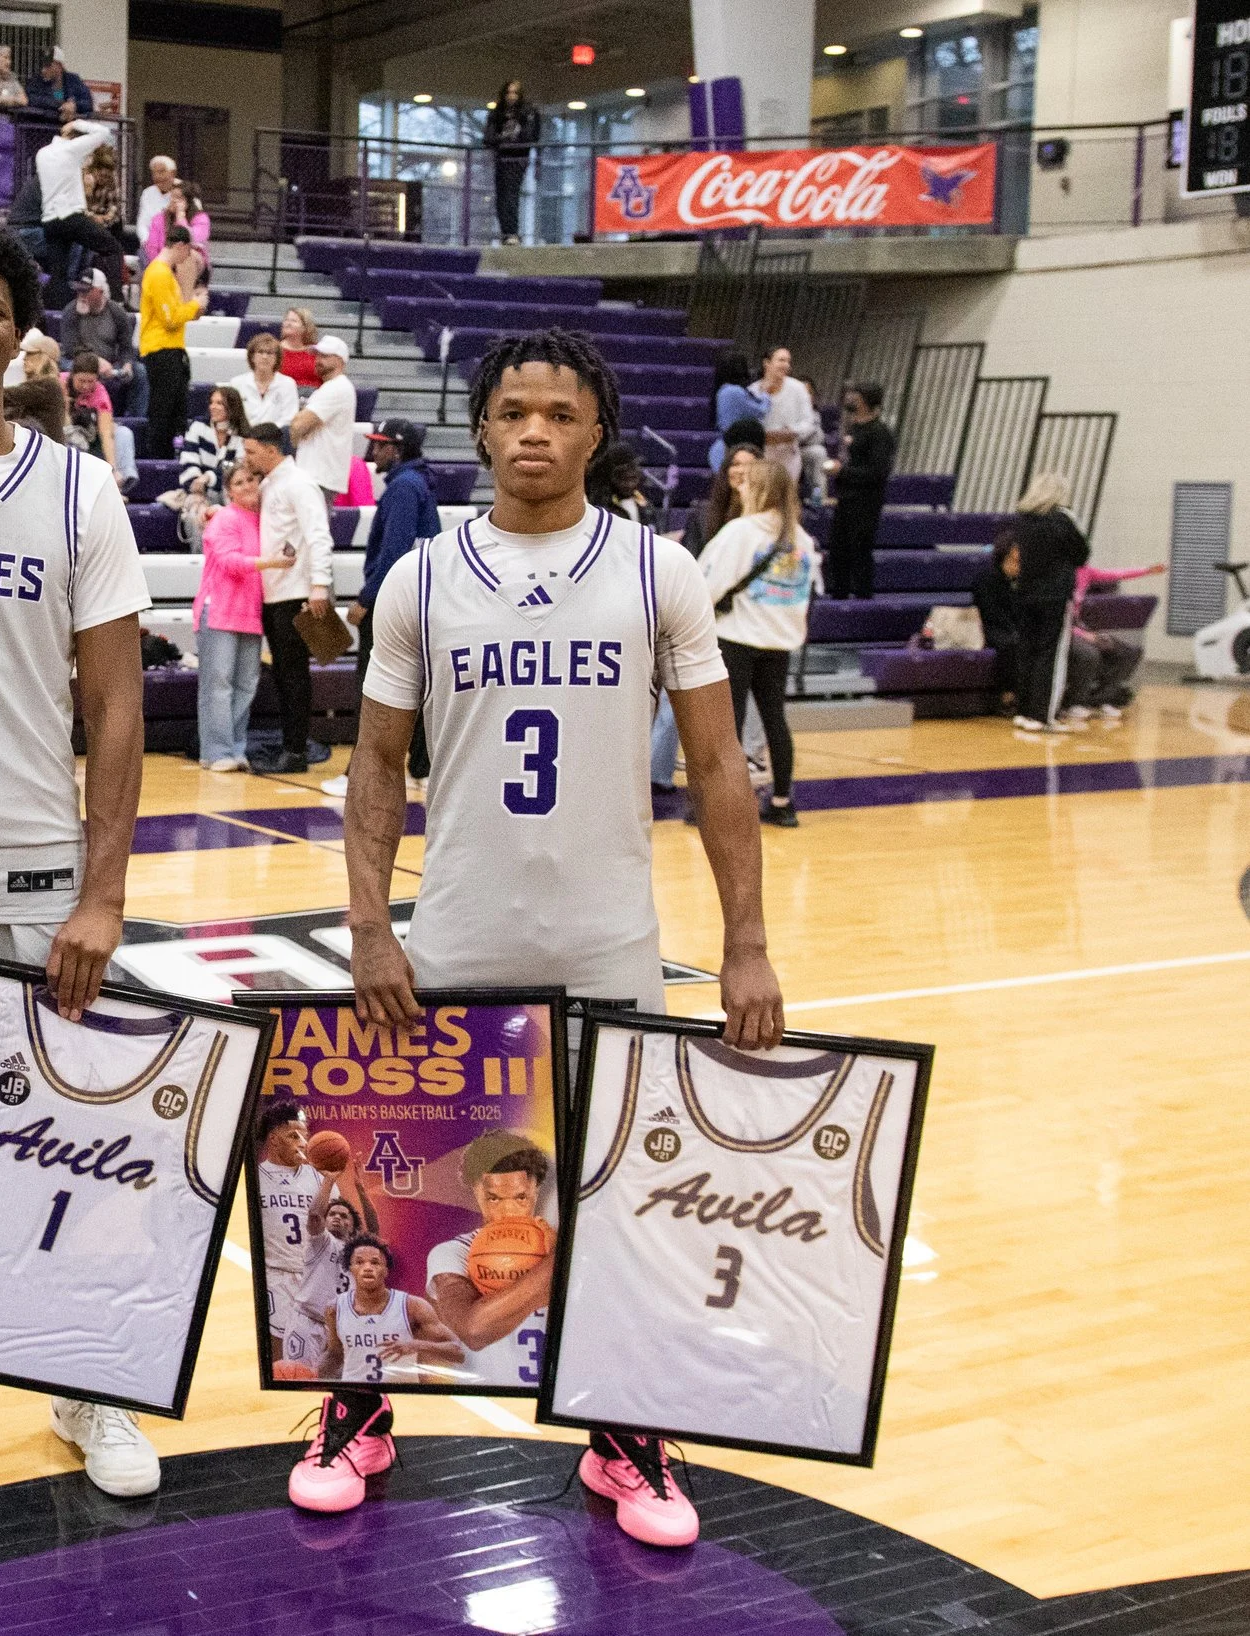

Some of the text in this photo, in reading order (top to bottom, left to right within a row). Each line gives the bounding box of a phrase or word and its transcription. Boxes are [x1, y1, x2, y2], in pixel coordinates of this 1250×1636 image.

[1217, 18, 1250, 48] HO
[1202, 103, 1248, 127] FOULS
[677, 150, 905, 225] Coca-Cola
[449, 640, 623, 693] EAGLES
[502, 708, 560, 816] 3
[268, 1006, 472, 1058] JAMES
[0, 1061, 31, 1072] adidas
[261, 1056, 467, 1097] ROSS
[0, 1076, 26, 1096] JB
[3, 1094, 19, 1104] #21
[158, 1089, 185, 1112] DC
[305, 1104, 338, 1120] AVILA
[340, 1104, 377, 1120] MEN'S
[380, 1104, 457, 1120] BASKETBALL
[649, 1133, 676, 1152] JB
[820, 1129, 847, 1151] DC
[364, 1130, 426, 1198] AU
[261, 1194, 313, 1209] EAGLES
[634, 1171, 828, 1243] Avila
[37, 1189, 72, 1253] 1
[282, 1212, 303, 1246] 3
[477, 1264, 530, 1280] SPALD
[705, 1244, 744, 1310] 3
[365, 1353, 384, 1383] 3
[517, 1328, 547, 1383] 3
